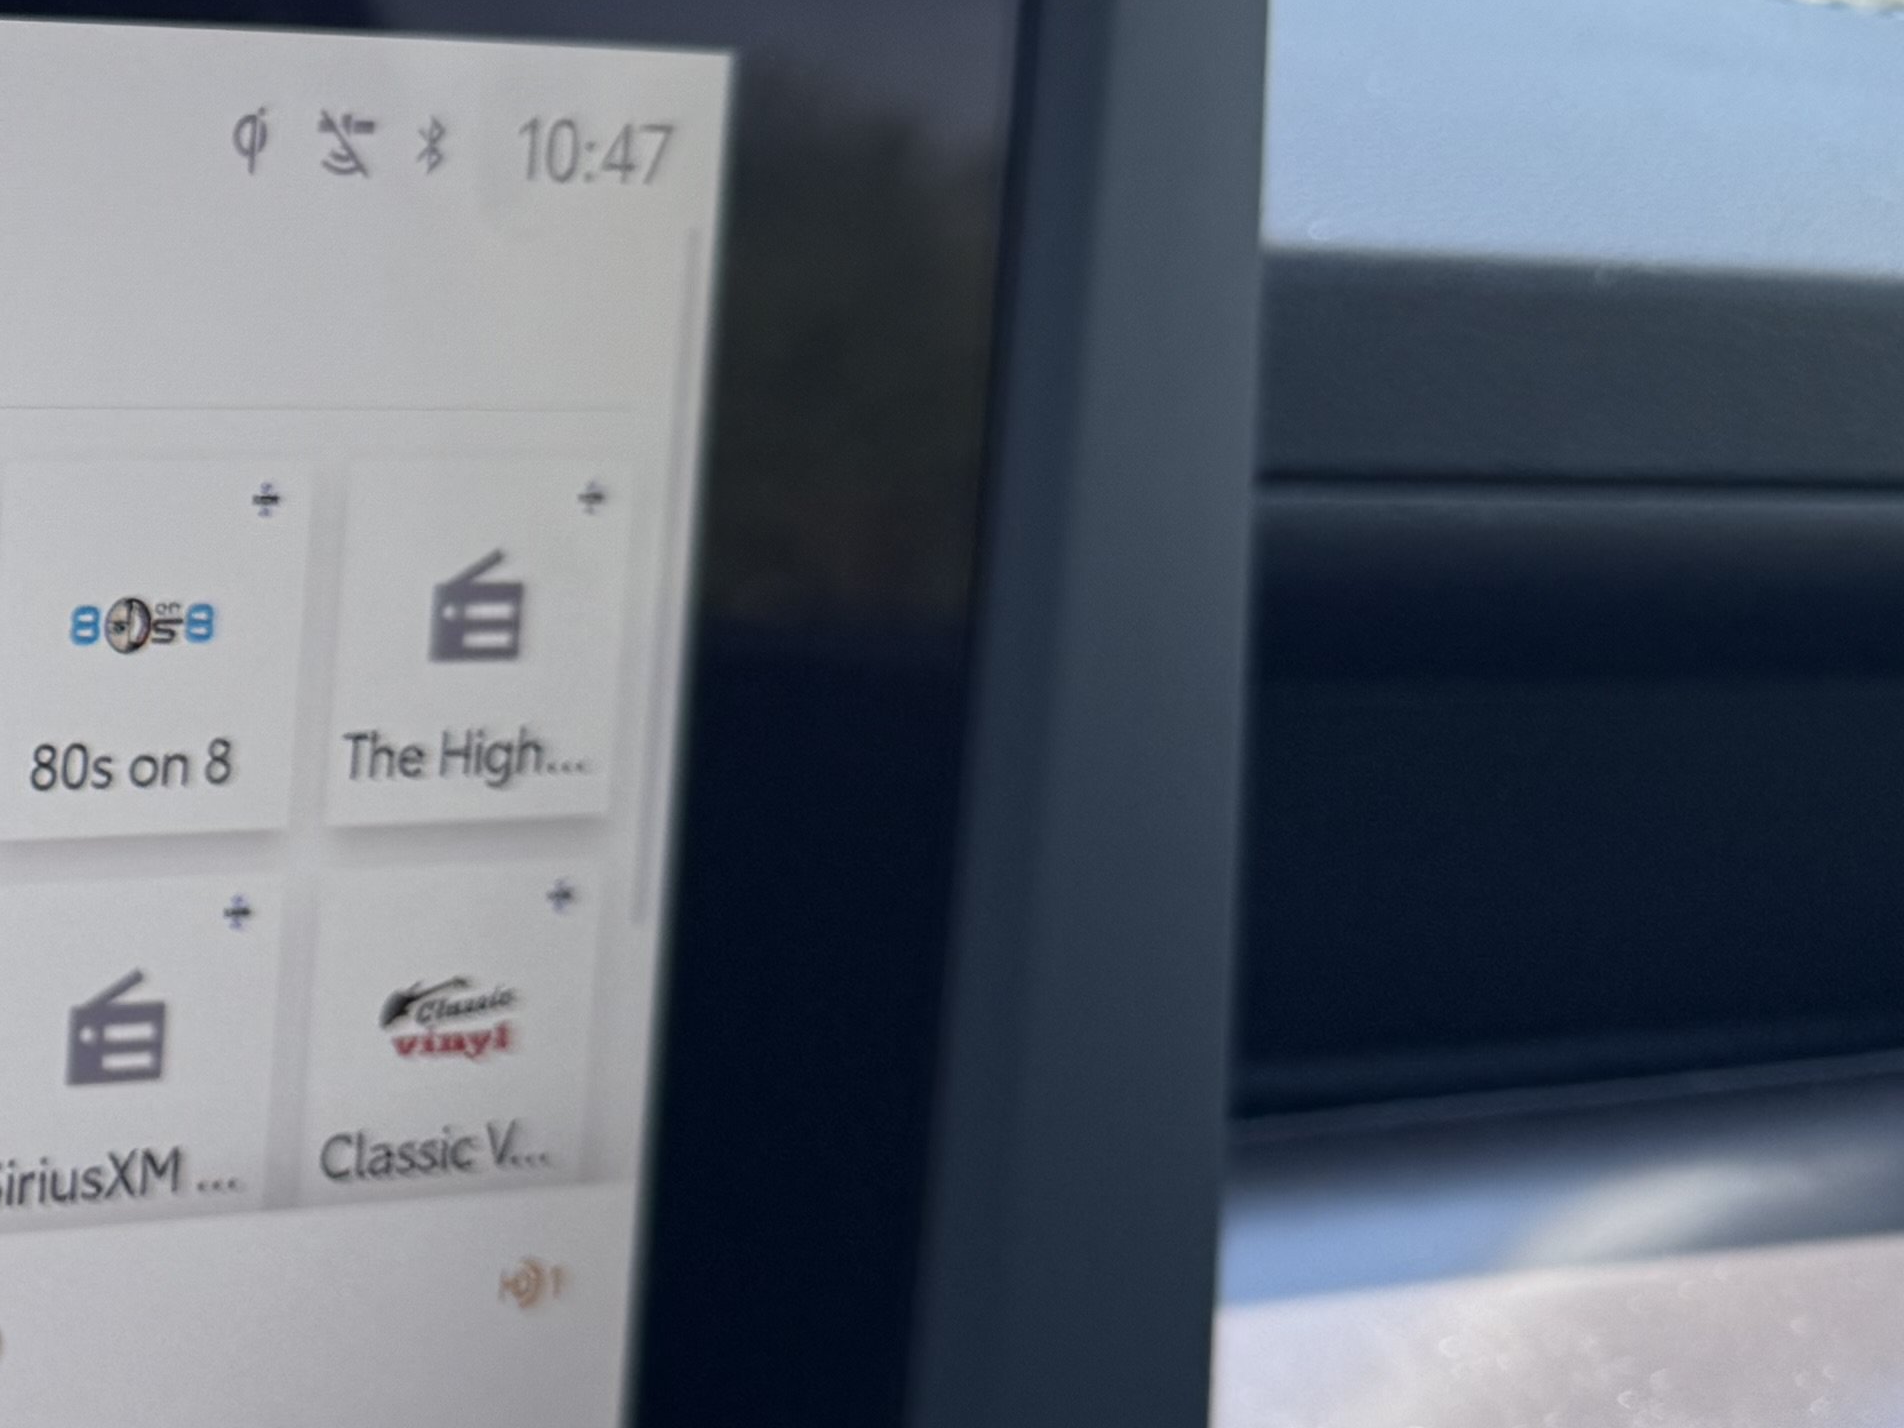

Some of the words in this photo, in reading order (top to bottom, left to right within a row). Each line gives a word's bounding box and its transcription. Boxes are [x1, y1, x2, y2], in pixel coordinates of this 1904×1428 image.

[518, 117, 677, 184] 10:47
[30, 743, 114, 791] 80s
[129, 753, 193, 789] on
[206, 740, 233, 786] 8
[343, 730, 424, 781] The
[437, 725, 586, 786] High...
[320, 1123, 478, 1183] Classic
